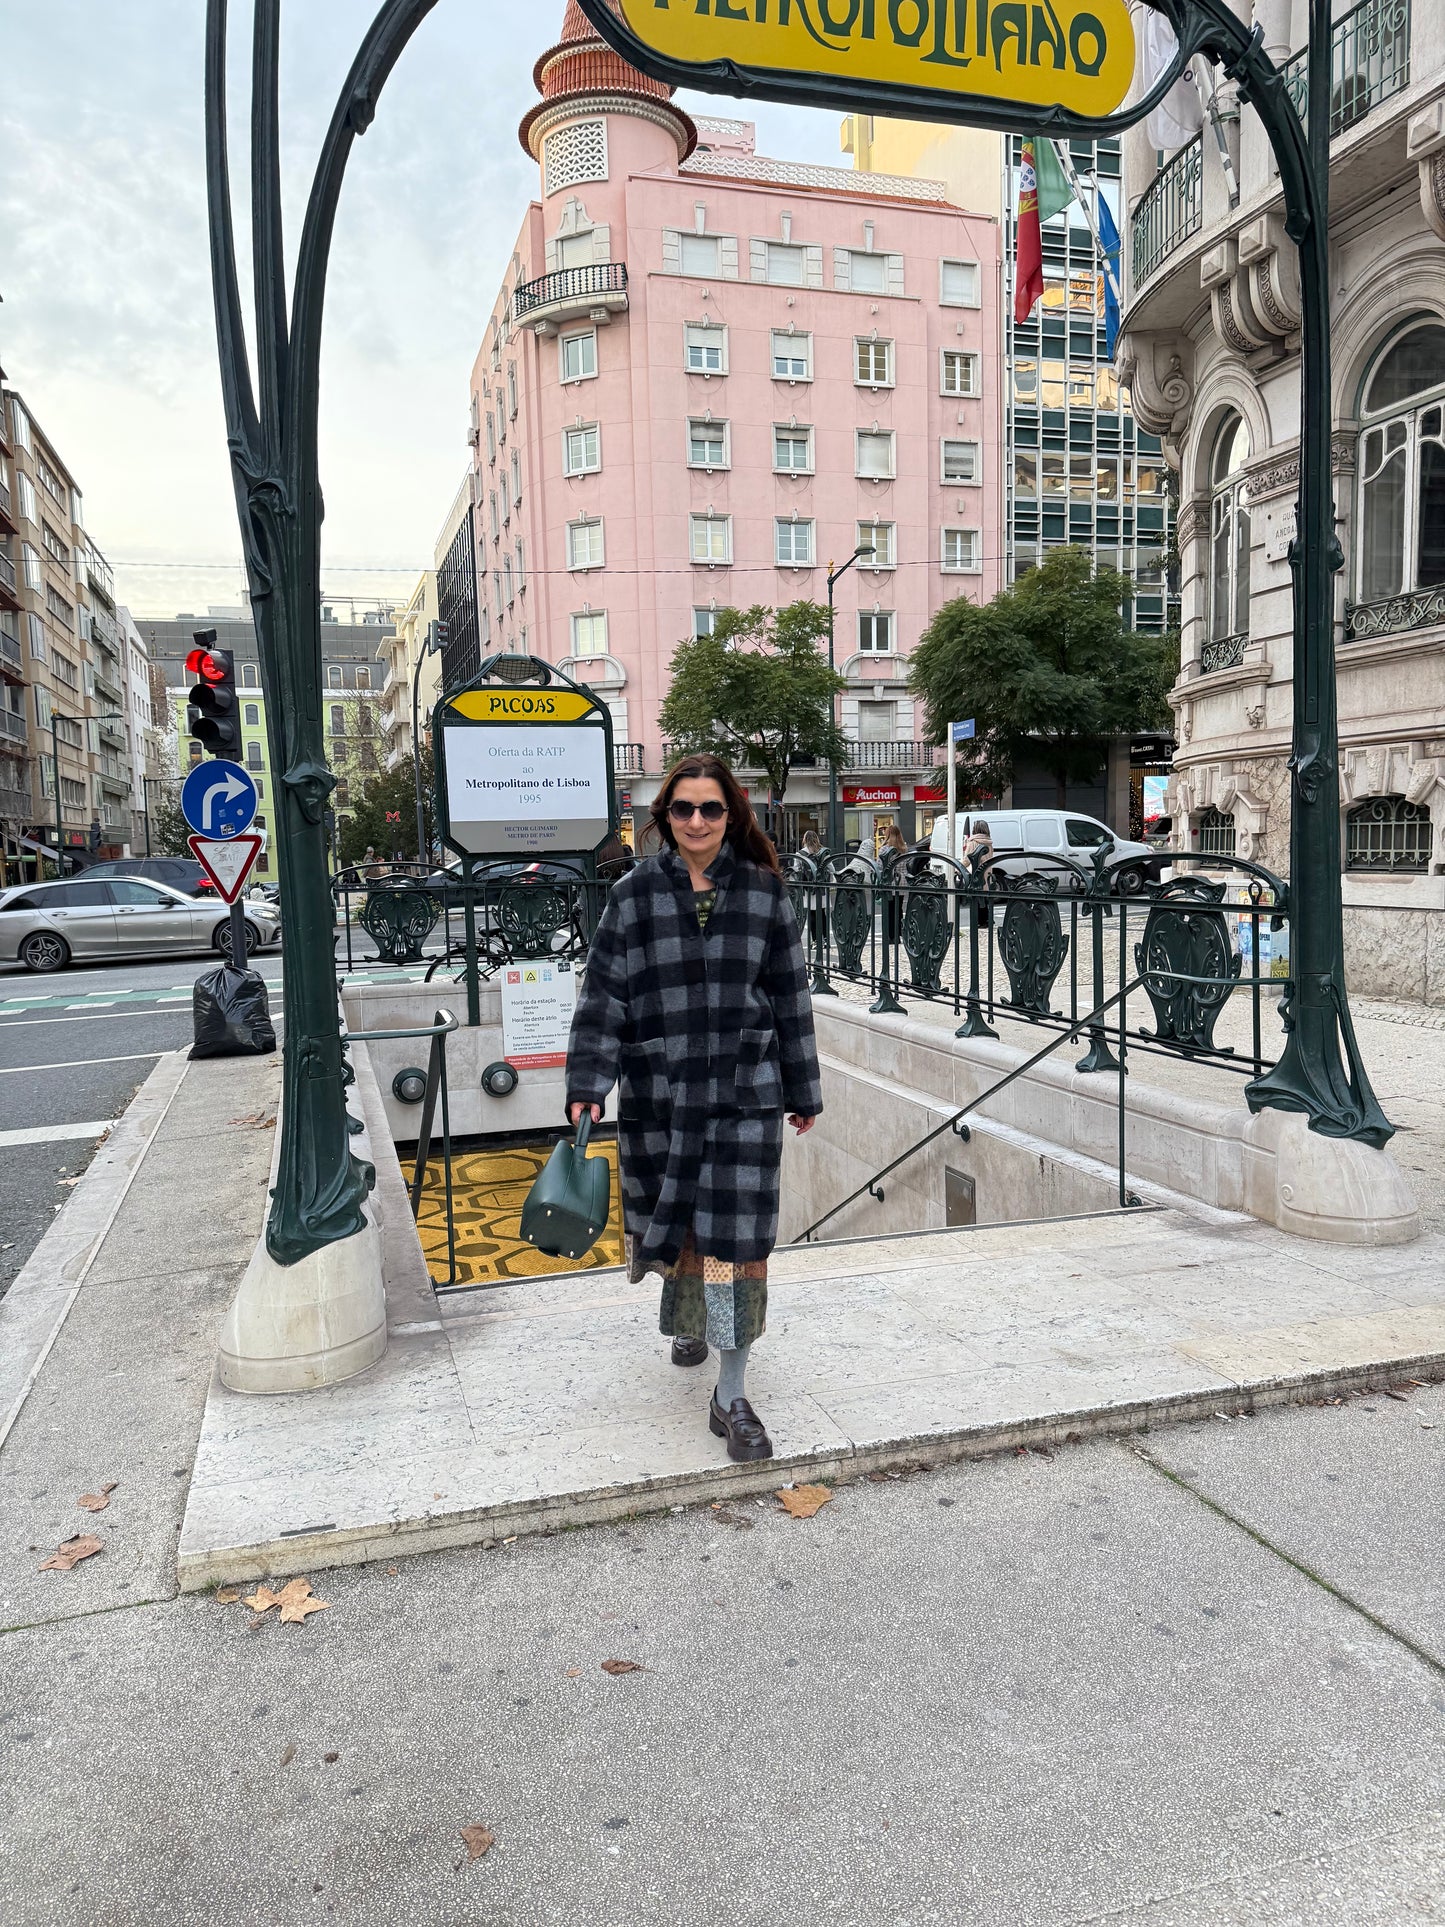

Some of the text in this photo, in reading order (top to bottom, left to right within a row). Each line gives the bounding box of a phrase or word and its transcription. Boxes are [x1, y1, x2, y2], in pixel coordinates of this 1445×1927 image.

[654, 0, 1107, 76] OOLITANO
[490, 698, 555, 713] PICOAS
[488, 747, 565, 756] Oferta da RATP
[465, 778, 590, 790] Metropolitano de Lisboa
[519, 794, 541, 803] 1995
[856, 788, 896, 800] Auchan
